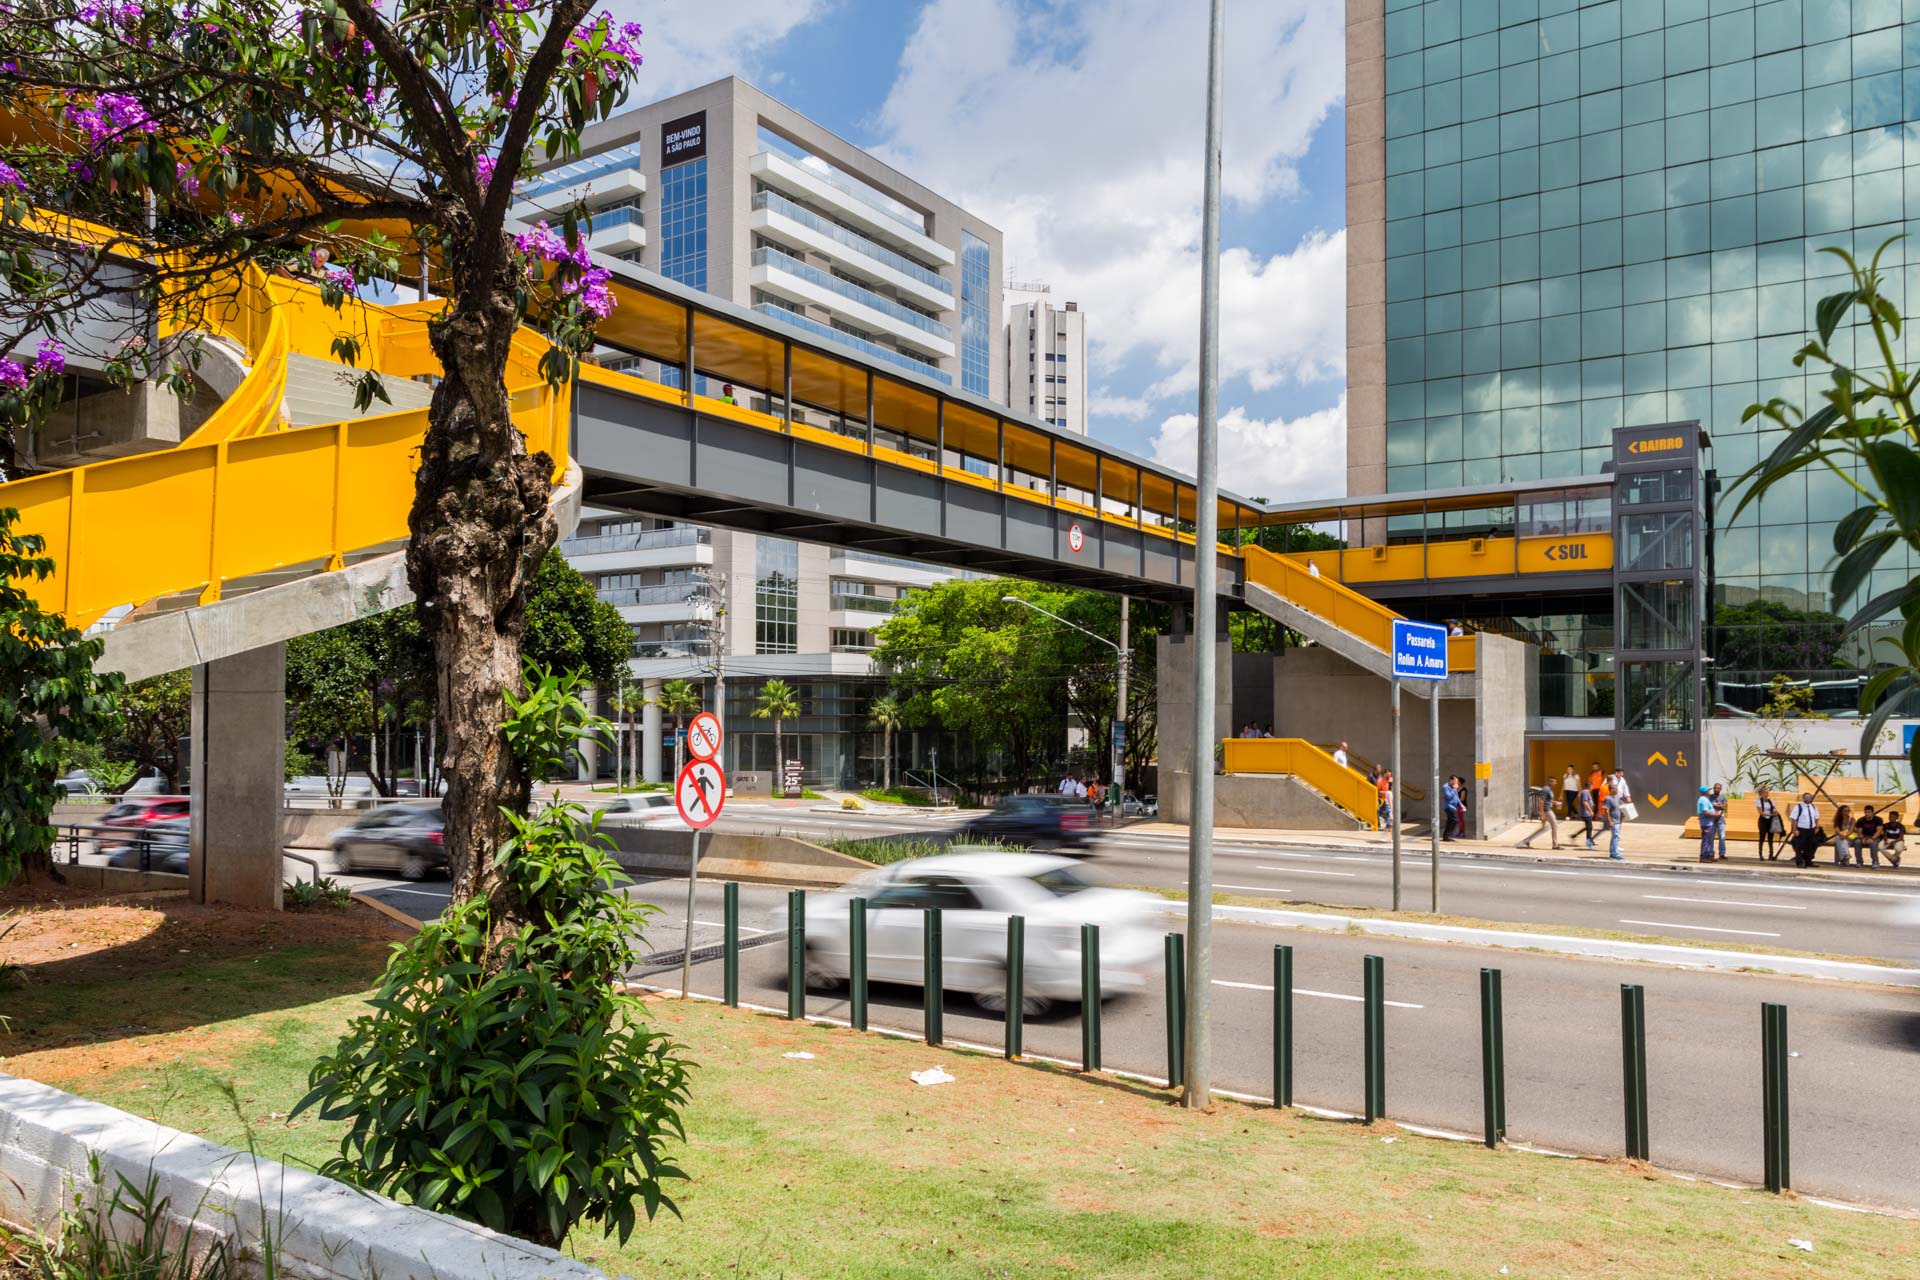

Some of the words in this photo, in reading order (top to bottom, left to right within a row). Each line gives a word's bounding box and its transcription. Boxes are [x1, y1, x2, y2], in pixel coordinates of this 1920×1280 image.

[666, 125, 701, 144] BEM-VINDO
[666, 145, 671, 155] A
[671, 141, 683, 153] SÃO
[683, 137, 701, 149] PAULO
[1639, 436, 1684, 453] BAIRRO
[1558, 544, 1588, 560] SUL
[1406, 633, 1436, 649] Passarela
[1397, 652, 1416, 666] Rolim
[1416, 654, 1424, 667] A.
[1424, 656, 1444, 669] Amaro
